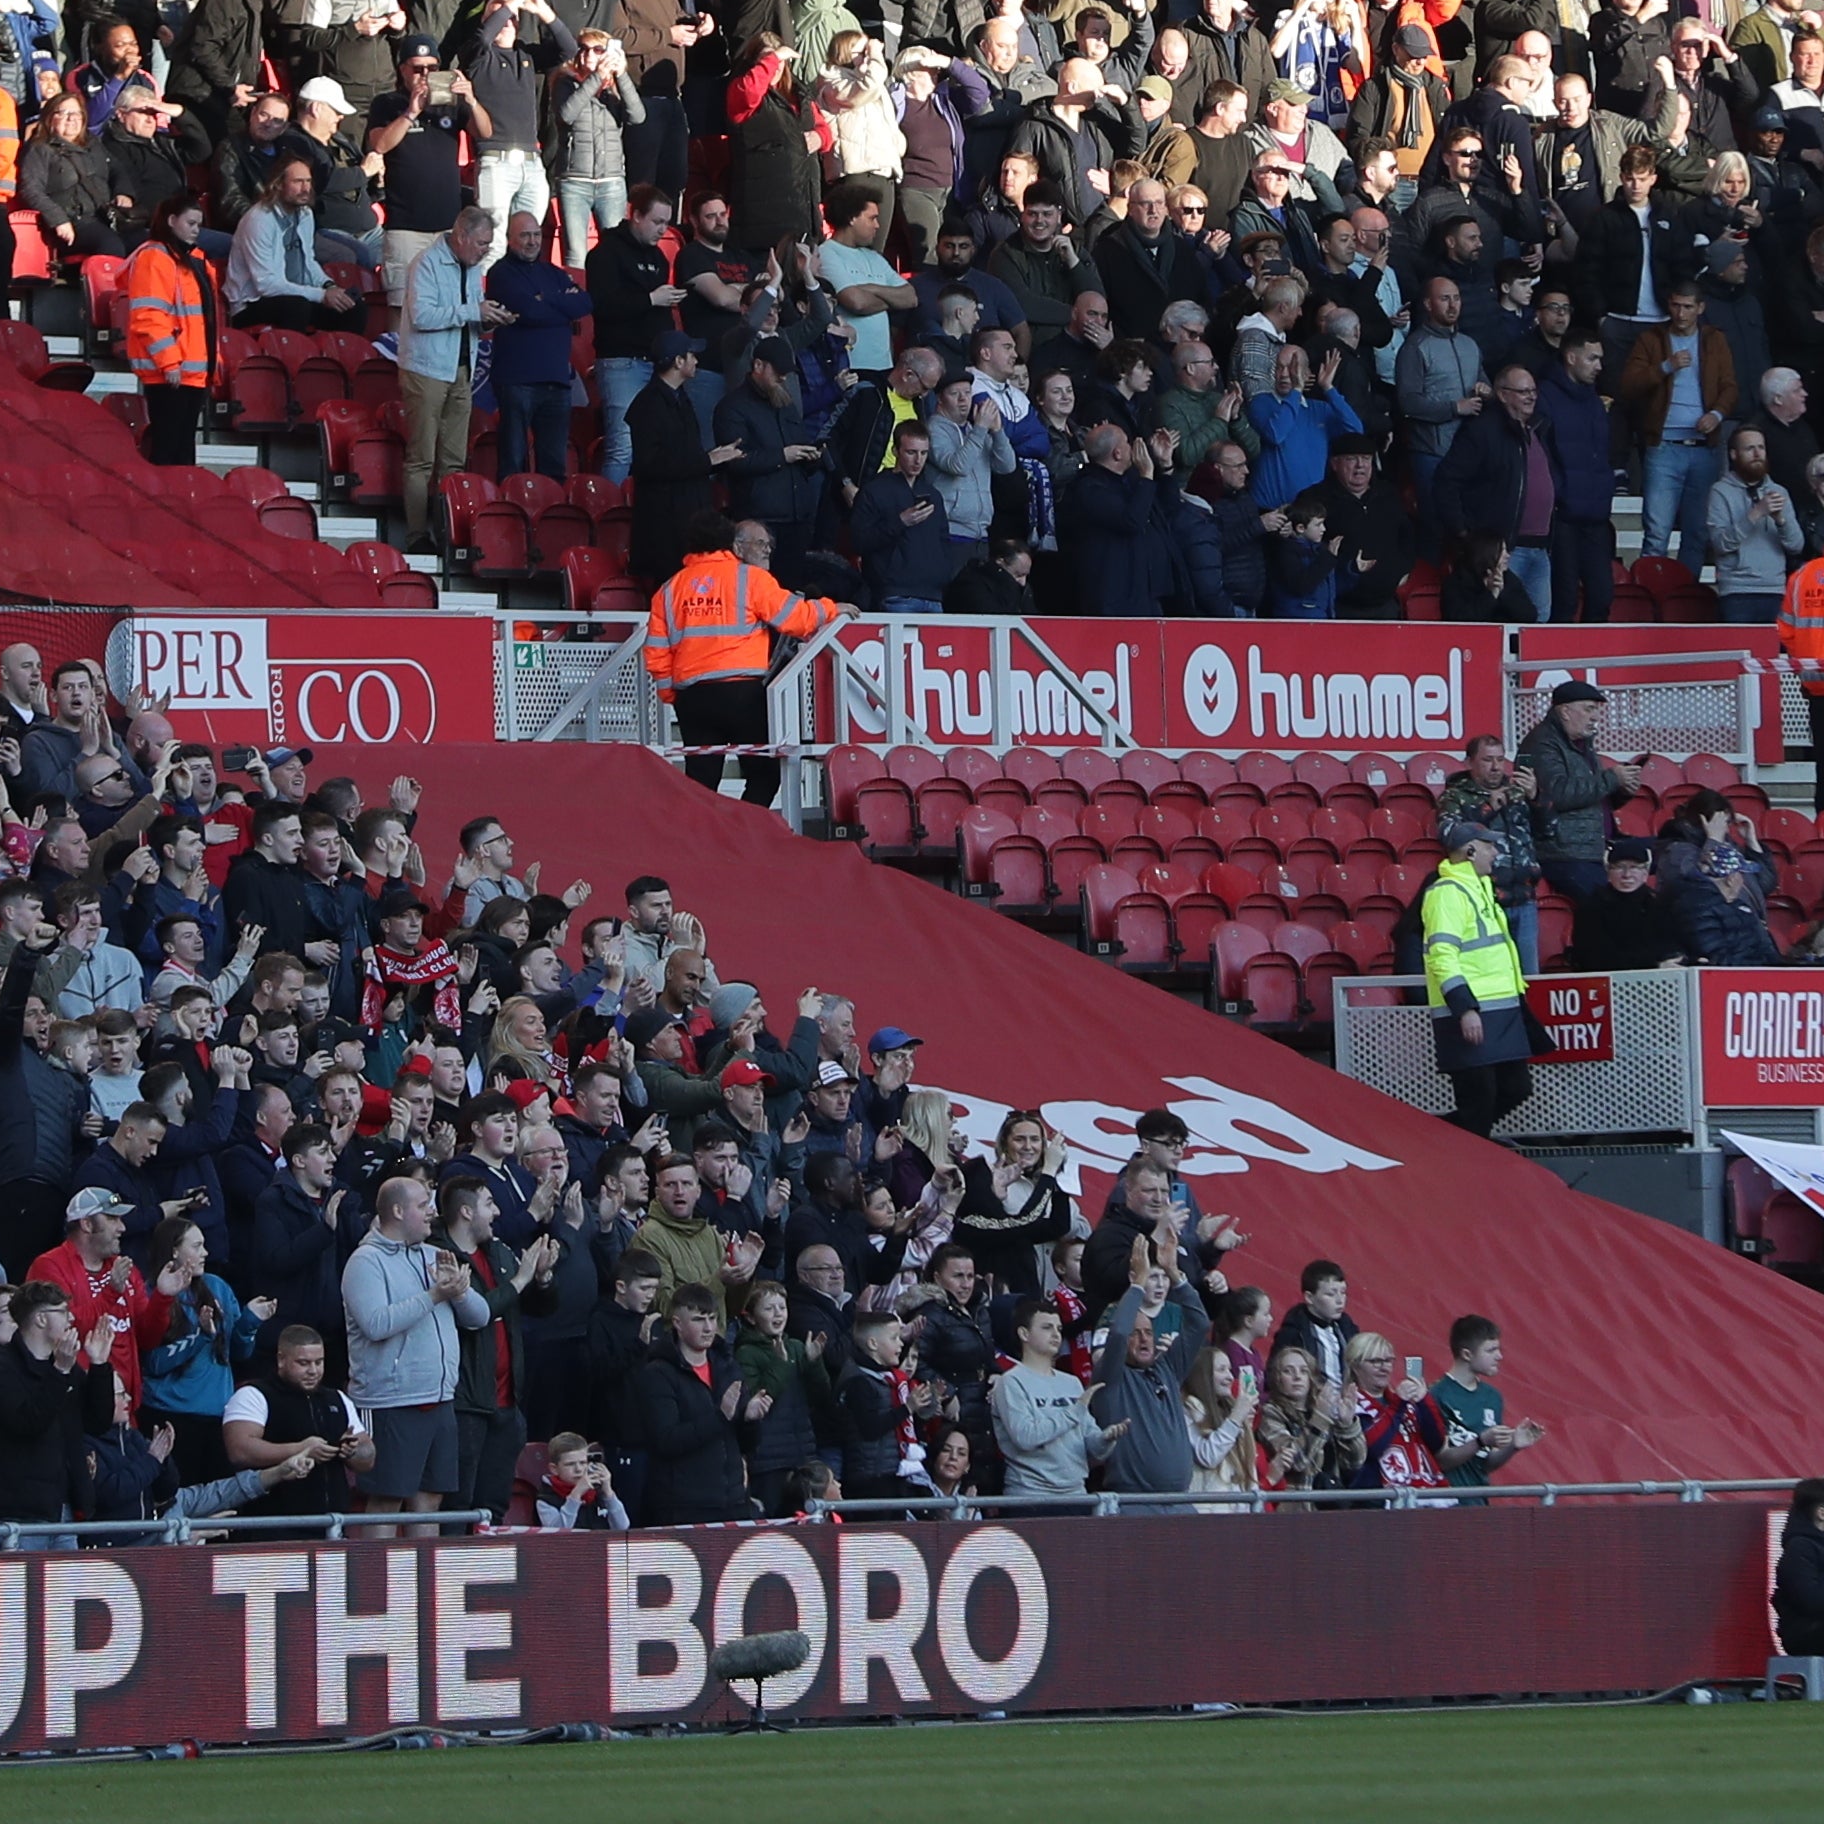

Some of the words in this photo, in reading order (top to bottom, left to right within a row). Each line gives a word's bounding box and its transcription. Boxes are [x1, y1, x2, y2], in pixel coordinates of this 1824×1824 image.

[682, 597, 723, 607] ALPHA
[270, 668, 286, 744] FOODS
[297, 669, 402, 744] CO
[1248, 644, 1463, 739] hummel
[1549, 988, 1581, 1016] NO
[1545, 1022, 1602, 1051] NTRY
[1757, 1062, 1824, 1083] BUSINESS
[210, 1545, 523, 1730] THE
[605, 1524, 1051, 1712] BORO
